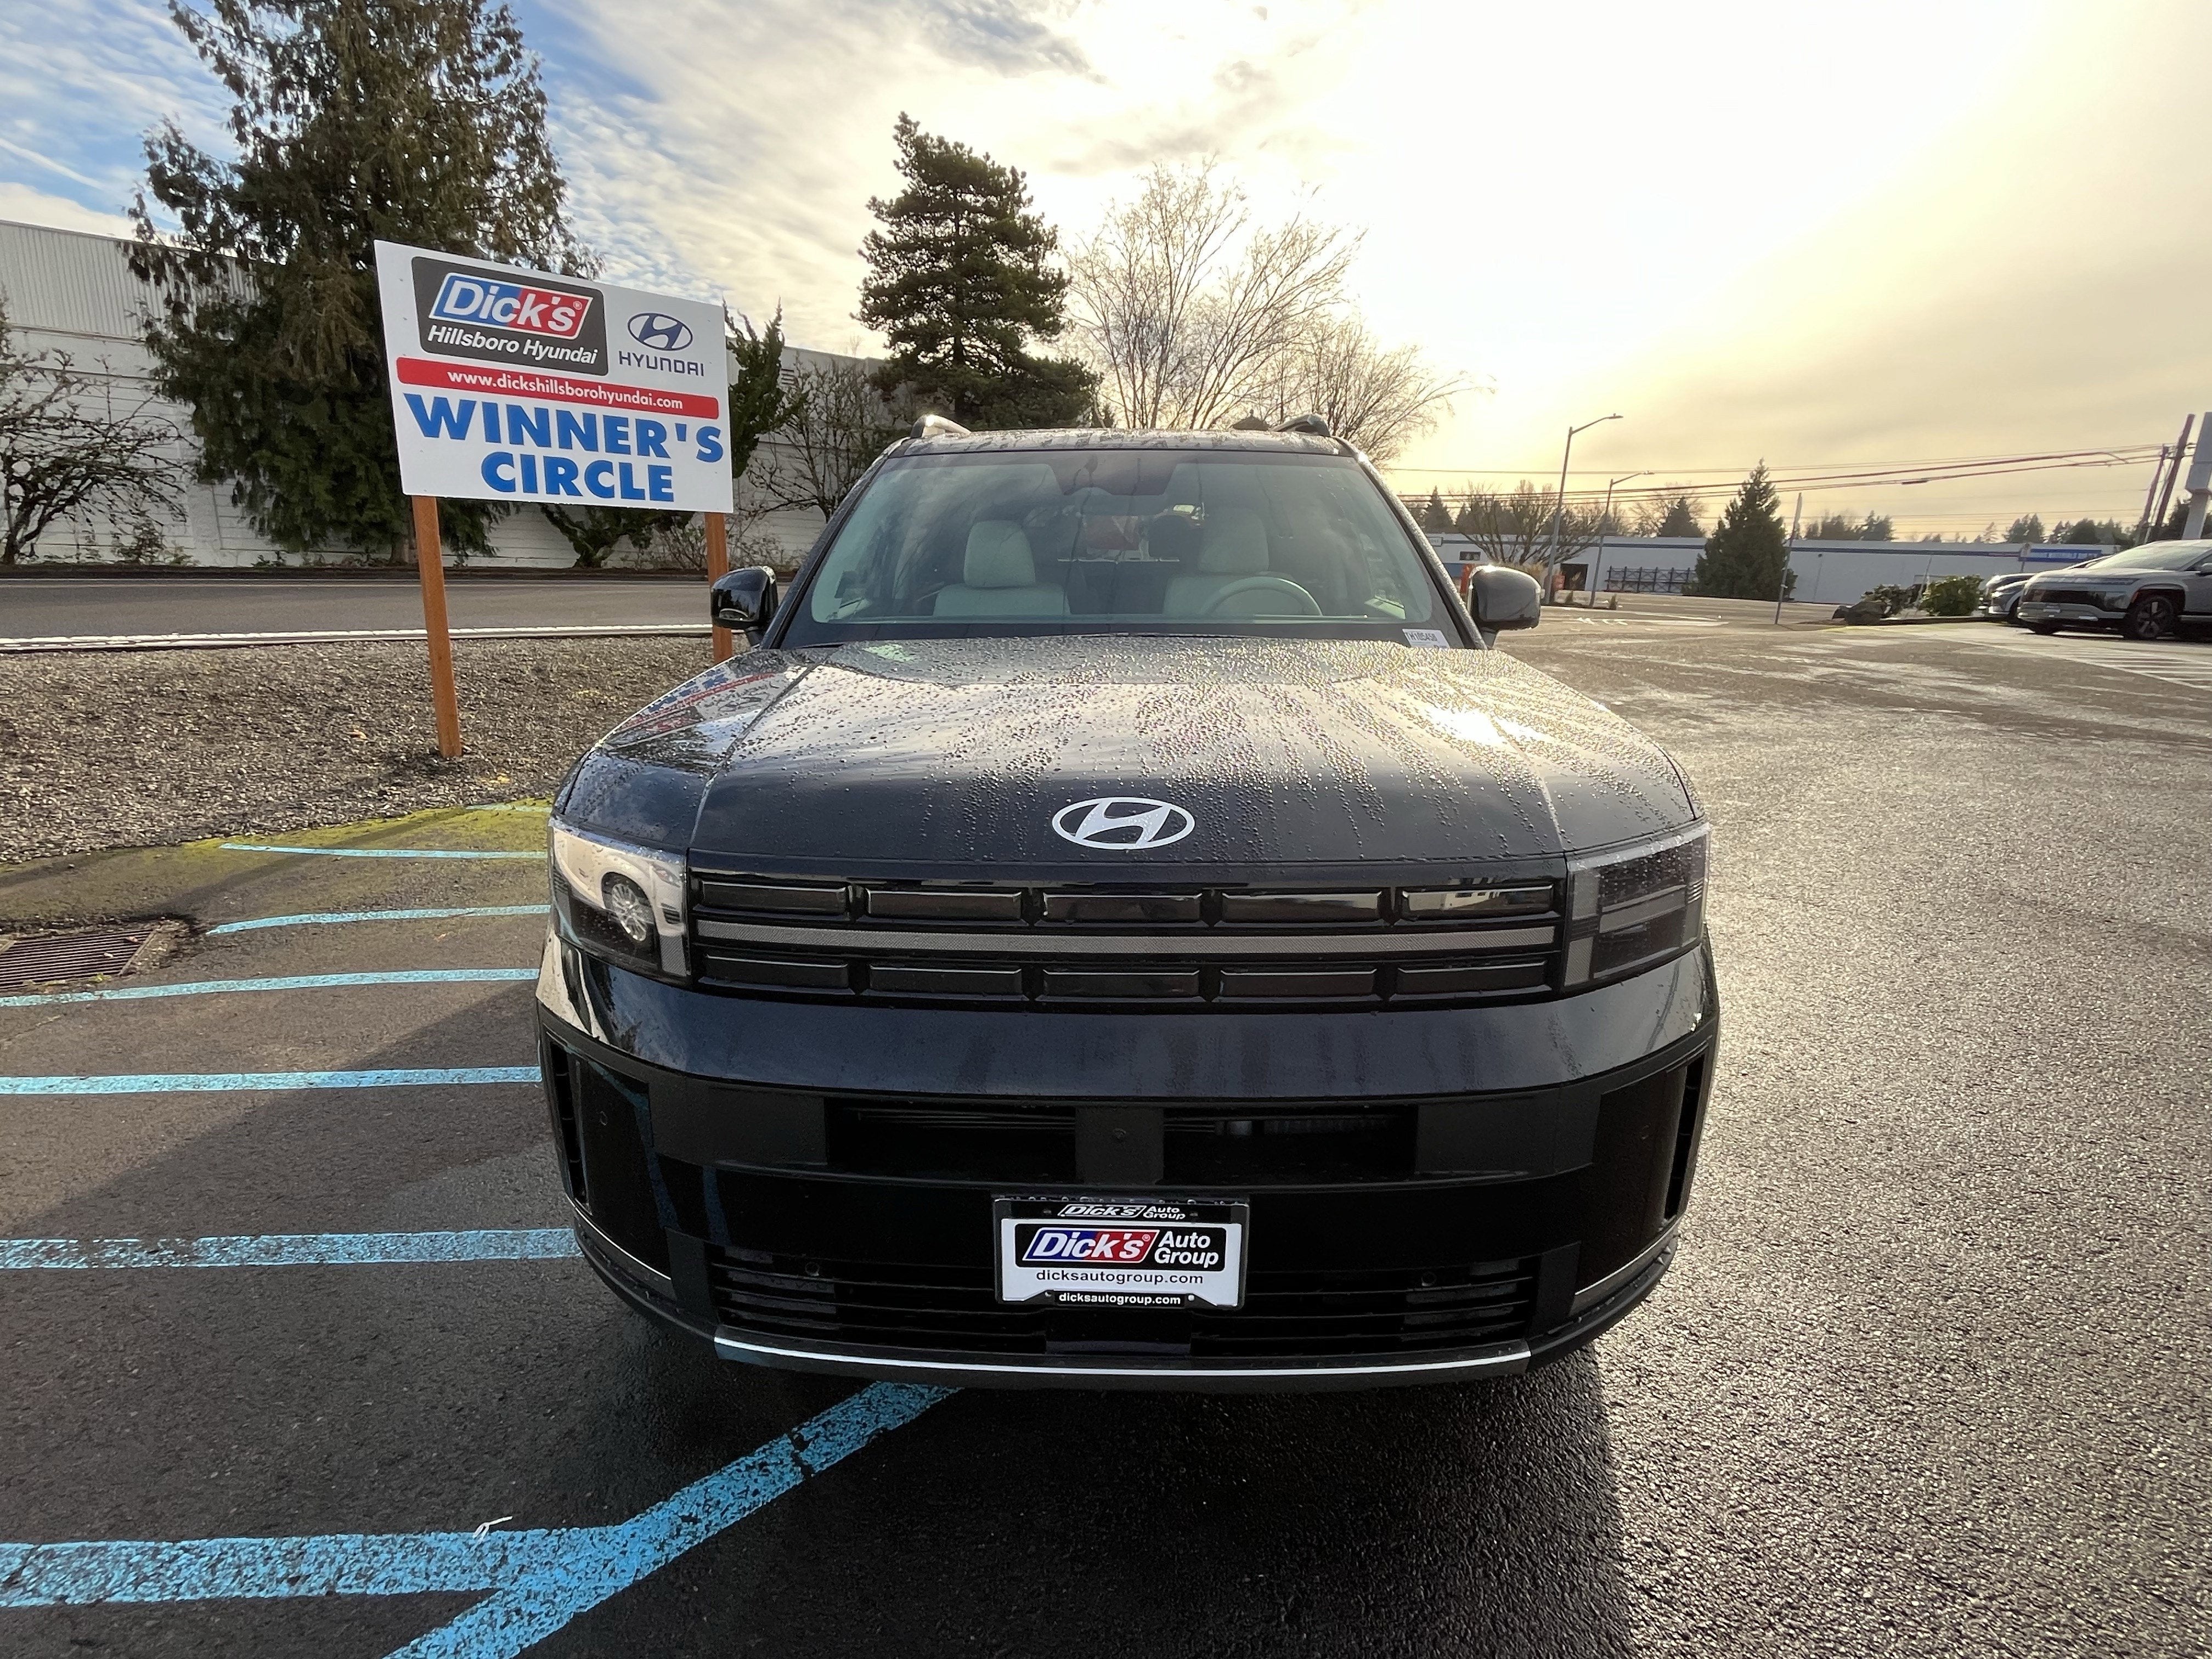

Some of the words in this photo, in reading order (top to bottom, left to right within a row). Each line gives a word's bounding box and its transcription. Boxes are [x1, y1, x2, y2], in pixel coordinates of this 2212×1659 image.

[427, 325, 520, 354] Hillsboro
[523, 338, 599, 364] Hyundai
[619, 351, 704, 377] HYUNDAI
[447, 369, 684, 410] www.dickshillsborohyundai.com
[403, 392, 724, 463] WINNER'S
[481, 451, 675, 503] CIRCLE
[1143, 1212, 1186, 1221] Group
[1147, 1205, 1180, 1214] Auto
[1158, 1231, 1211, 1249] Auto
[1154, 1247, 1220, 1268] Group
[1036, 1269, 1204, 1285] dicksautogroup.com
[1059, 1293, 1181, 1306] dicksautogroup.com
